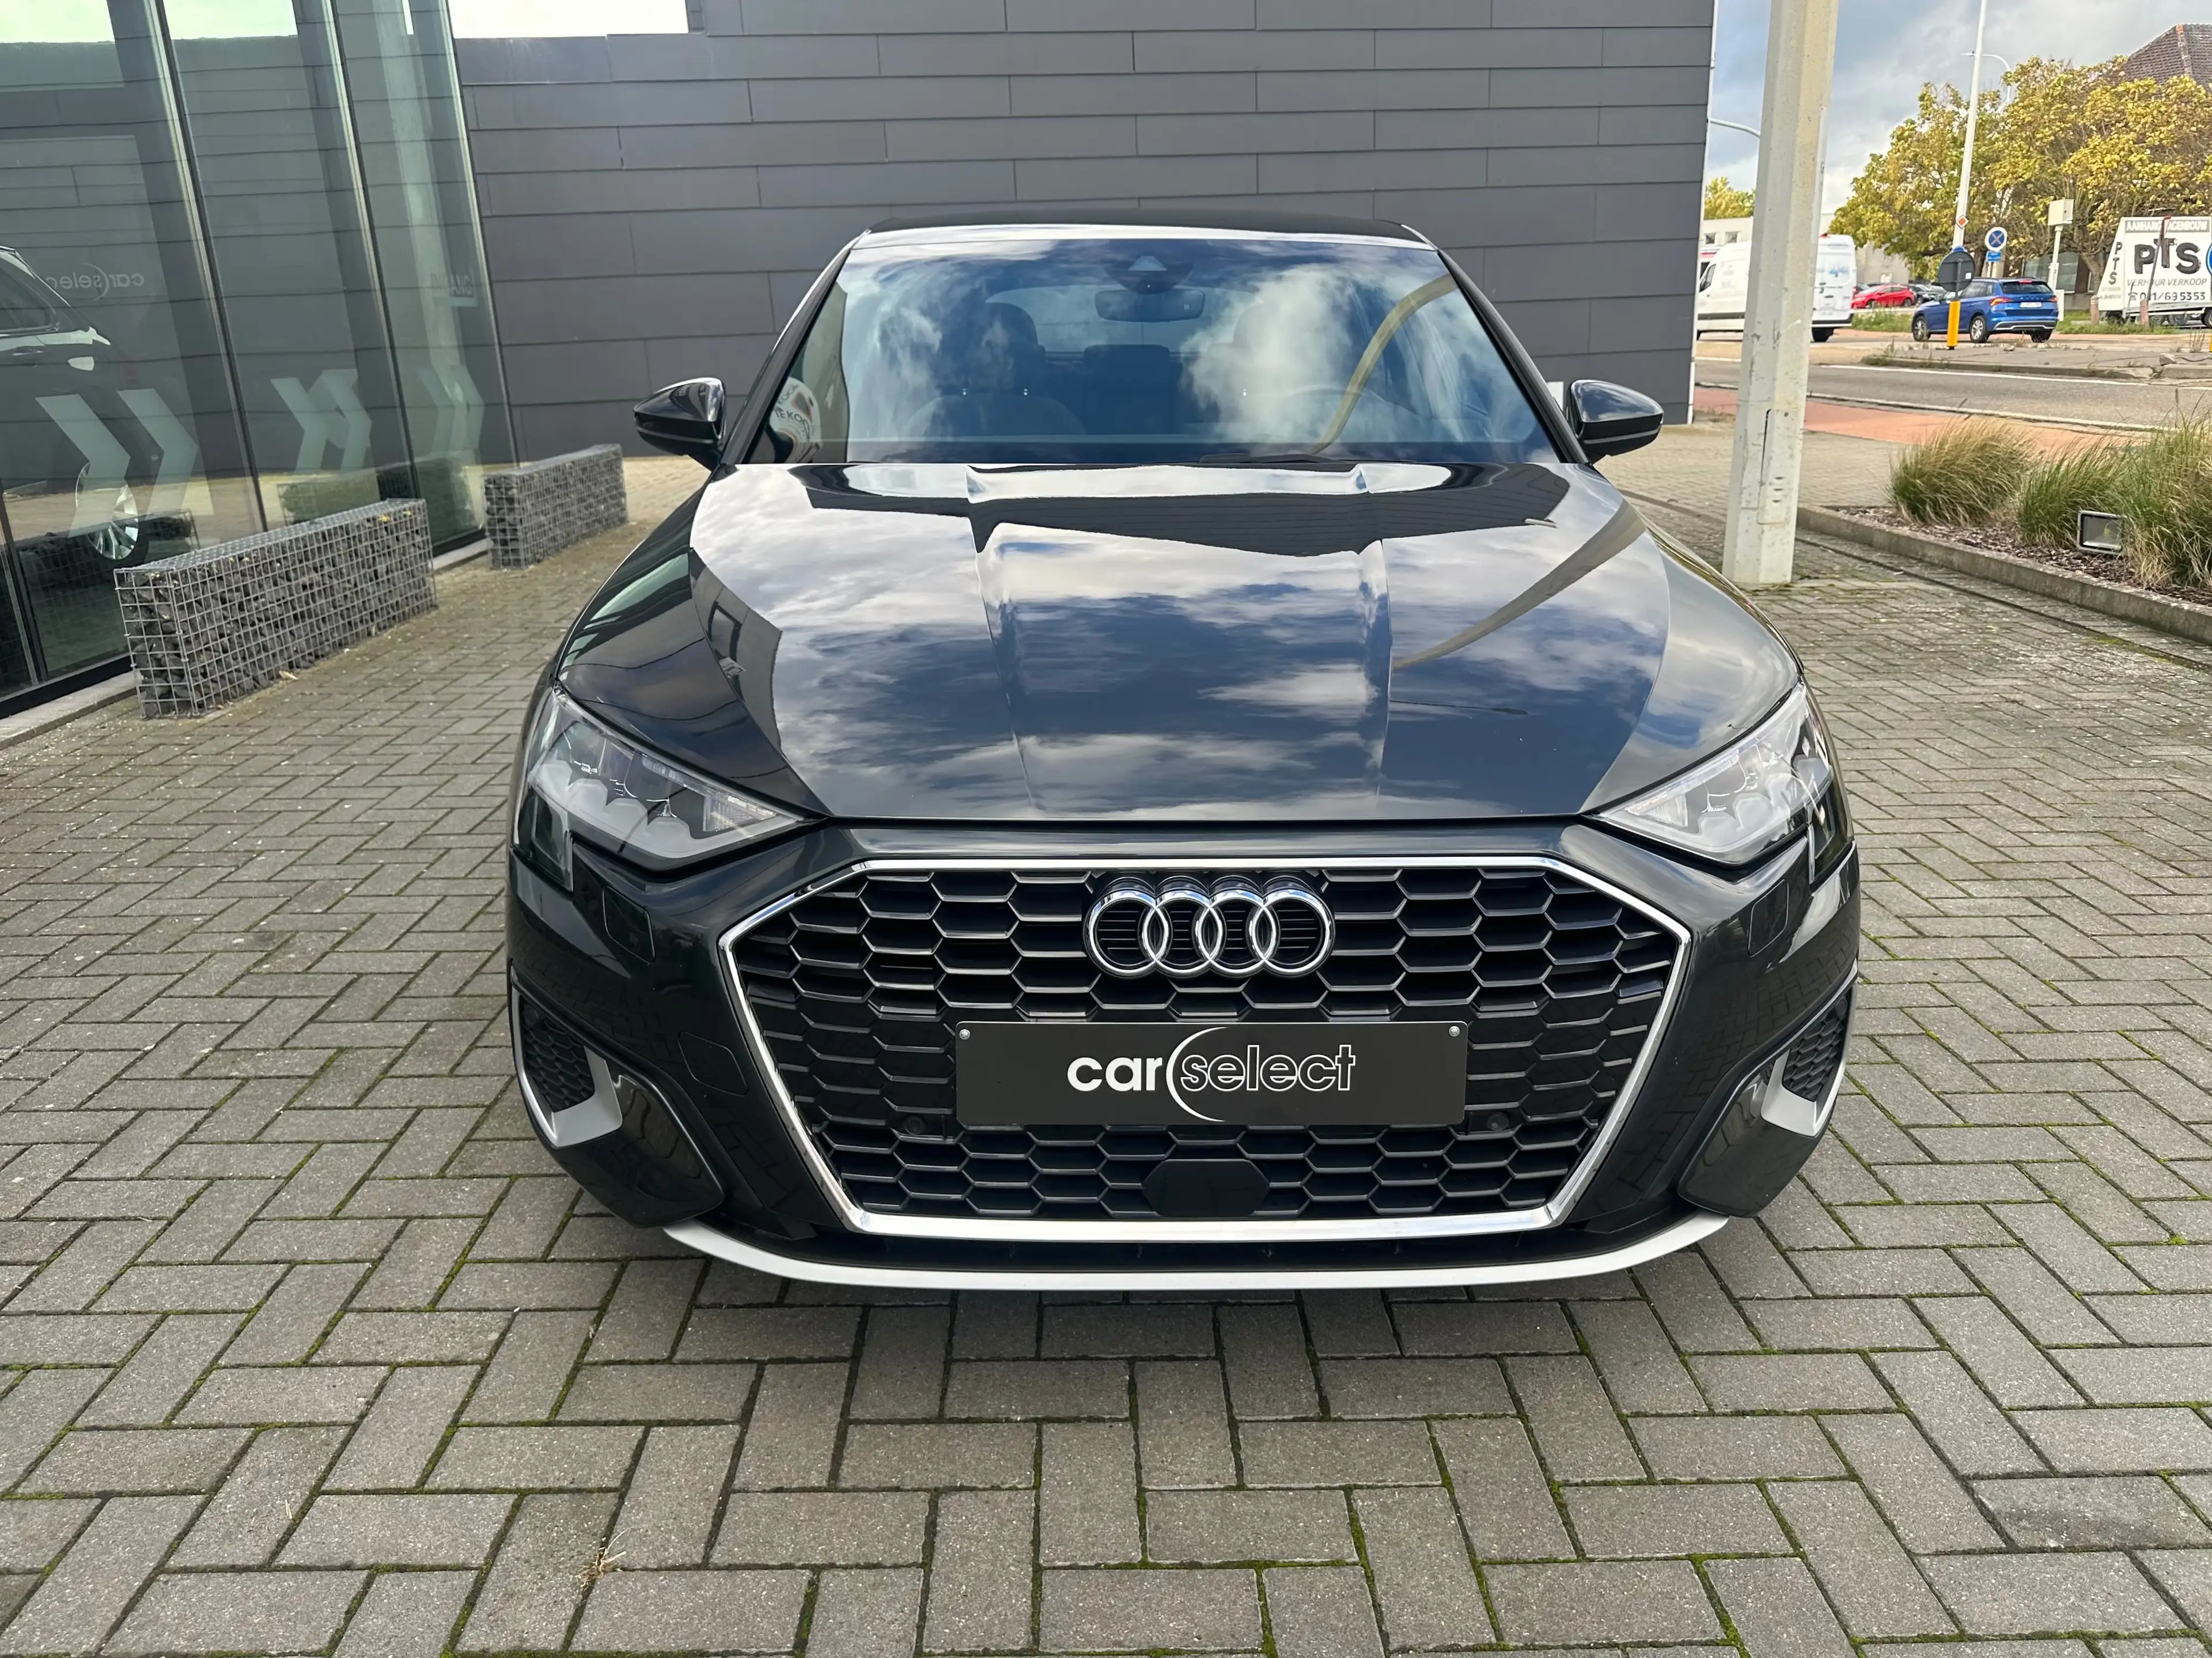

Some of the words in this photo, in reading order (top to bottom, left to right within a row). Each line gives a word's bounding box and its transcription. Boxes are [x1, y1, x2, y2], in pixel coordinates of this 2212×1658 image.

[2126, 221, 2207, 231] AANHANGAGENBOUW
[2134, 238, 2200, 274] PTS
[1067, 1057, 1162, 1091] car
[1180, 1045, 1355, 1092] select
